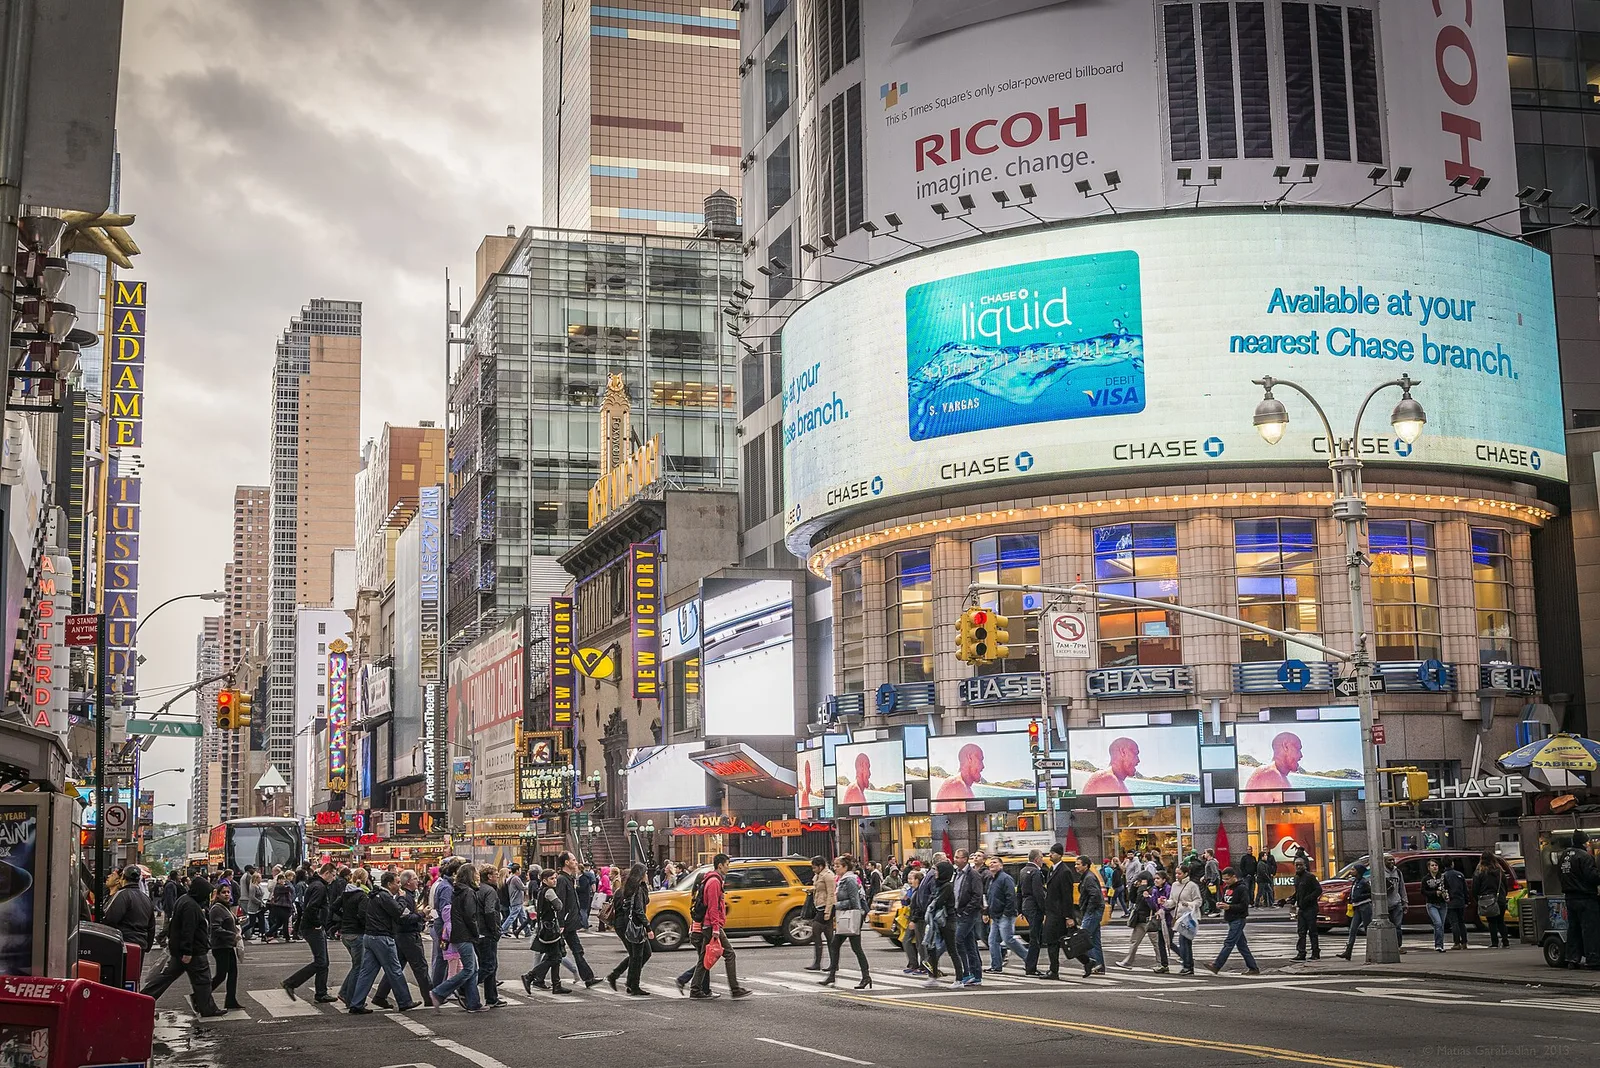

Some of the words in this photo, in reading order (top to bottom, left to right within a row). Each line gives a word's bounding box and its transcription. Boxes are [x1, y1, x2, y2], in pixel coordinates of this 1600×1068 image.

[885, 112, 900, 127] This
[901, 108, 908, 121] is
[909, 102, 933, 118] Times
[935, 89, 973, 109] Square's
[974, 84, 995, 99] only
[998, 68, 1072, 93] solar-powered
[1075, 61, 1124, 78] billboard
[915, 103, 1087, 172] RICOH
[916, 167, 998, 199] imagine.
[1005, 150, 1095, 177] change.
[980, 291, 1017, 305] CHASE
[1266, 286, 1380, 315] Available
[1387, 289, 1412, 317] at
[1419, 296, 1476, 326] your
[962, 287, 1072, 345] liquid
[112, 281, 144, 446] MADAME
[1229, 329, 1320, 355] nearest
[1326, 327, 1415, 362] Chase
[1422, 333, 1519, 380] branch.
[788, 379, 796, 405] at
[795, 362, 821, 405] your
[1105, 376, 1135, 386] DEBIT
[929, 404, 938, 416] S.
[942, 397, 980, 413] VARGAS
[1084, 387, 1139, 407] VISA
[798, 391, 848, 437] branch.
[1114, 441, 1197, 461] CHASE
[1476, 444, 1528, 466] CHASE
[941, 456, 1010, 480] CHASE
[421, 489, 438, 519] NEW
[827, 480, 869, 506] CHASE
[421, 573, 438, 633] STUDIOS
[636, 550, 655, 639] VICTORY
[77, 617, 98, 625] STANDIN
[555, 601, 571, 676] VICTORY
[1055, 641, 1087, 650] 7AM-7PM
[421, 640, 438, 673] DUKE
[498, 652, 523, 719] COHEN
[638, 652, 656, 693] NEW
[1086, 667, 1190, 694] CHASE
[1343, 682, 1358, 692] ONE
[1369, 681, 1379, 689] AY
[555, 686, 571, 721] NEW
[958, 676, 1043, 701] CHASE
[150, 723, 157, 732] 7
[162, 725, 181, 734] Av
[330, 657, 346, 773] REGAL
[4, 811, 26, 820] YEAR!
[675, 812, 737, 828] ubwy
[15, 984, 52, 998] FREE
